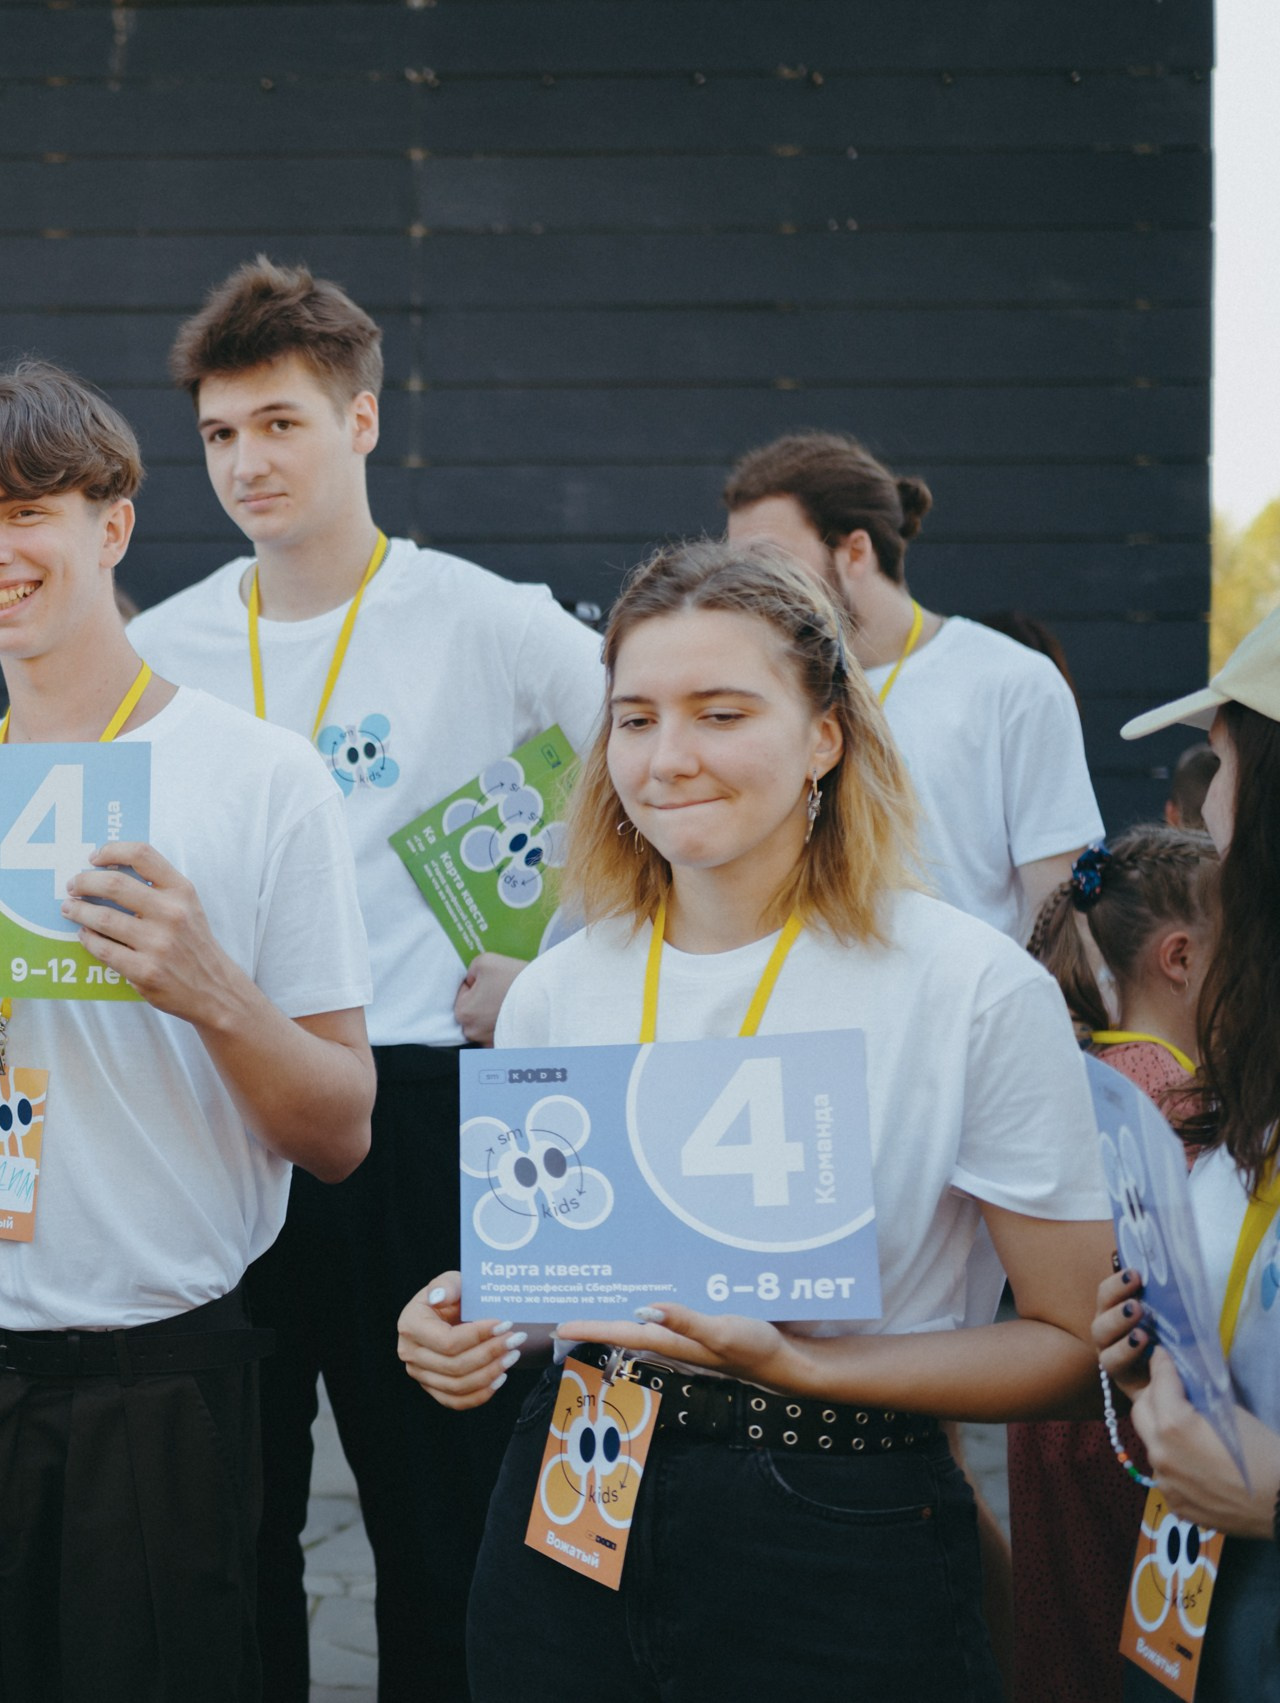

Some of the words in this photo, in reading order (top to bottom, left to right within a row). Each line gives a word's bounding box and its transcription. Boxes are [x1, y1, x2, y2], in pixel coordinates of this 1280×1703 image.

[360, 771, 381, 784] kids
[528, 811, 545, 828] sm
[0, 764, 96, 900] 4
[440, 851, 464, 890] Карта
[462, 888, 489, 932] квеста
[85, 967, 132, 985] ле
[510, 1070, 564, 1081] KIDS
[497, 1128, 524, 1146] sm
[681, 1057, 805, 1206] 4
[814, 1094, 836, 1204] Команда
[542, 1196, 580, 1220] kids
[481, 1262, 539, 1278] Карта
[545, 1264, 612, 1276] квеста
[480, 1283, 519, 1292] «Город
[522, 1283, 583, 1293] профессий
[585, 1283, 677, 1293] СберМаркетинг,
[790, 1276, 856, 1299] лет
[503, 1295, 522, 1303] что
[576, 1394, 596, 1408] sm
[588, 1485, 619, 1504] kids
[546, 1530, 600, 1569] Вожатый
